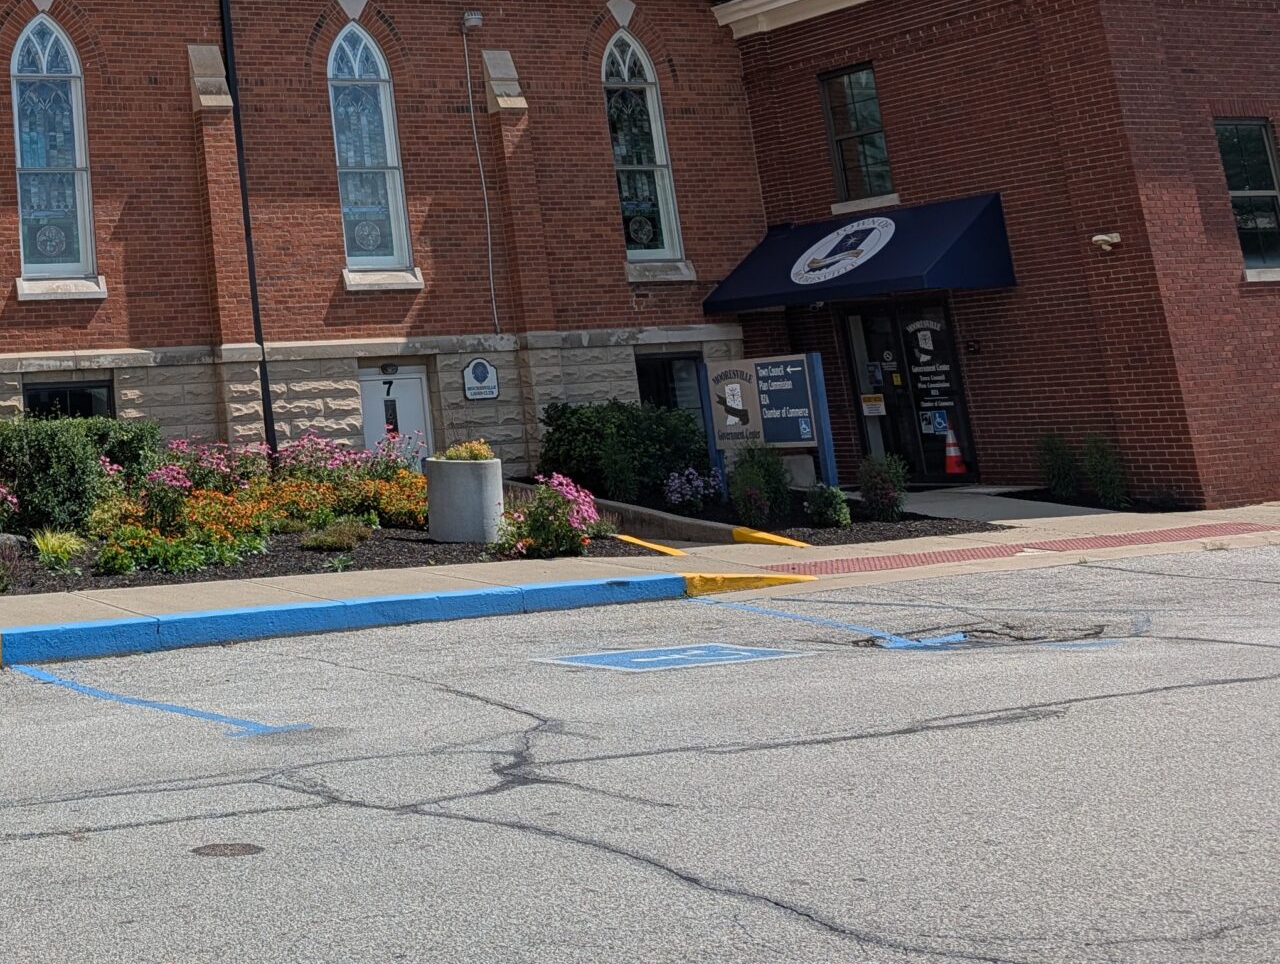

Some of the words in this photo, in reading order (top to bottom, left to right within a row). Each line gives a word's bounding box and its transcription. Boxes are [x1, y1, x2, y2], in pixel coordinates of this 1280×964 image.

[832, 219, 878, 236] TOWN
[906, 320, 942, 333] MOORESVILLE
[757, 366, 768, 377] Town
[768, 364, 785, 376] Council
[911, 365, 936, 373] Government
[936, 363, 950, 371] Center
[711, 369, 753, 385] MOORESVILLE
[382, 380, 394, 397] 7
[759, 381, 768, 390] Plan
[769, 378, 793, 390] Commission
[760, 394, 770, 404] BZA
[762, 407, 781, 418] Chamber
[786, 407, 809, 417] Commerce
[718, 428, 745, 440] Government
[745, 428, 760, 440] Center
